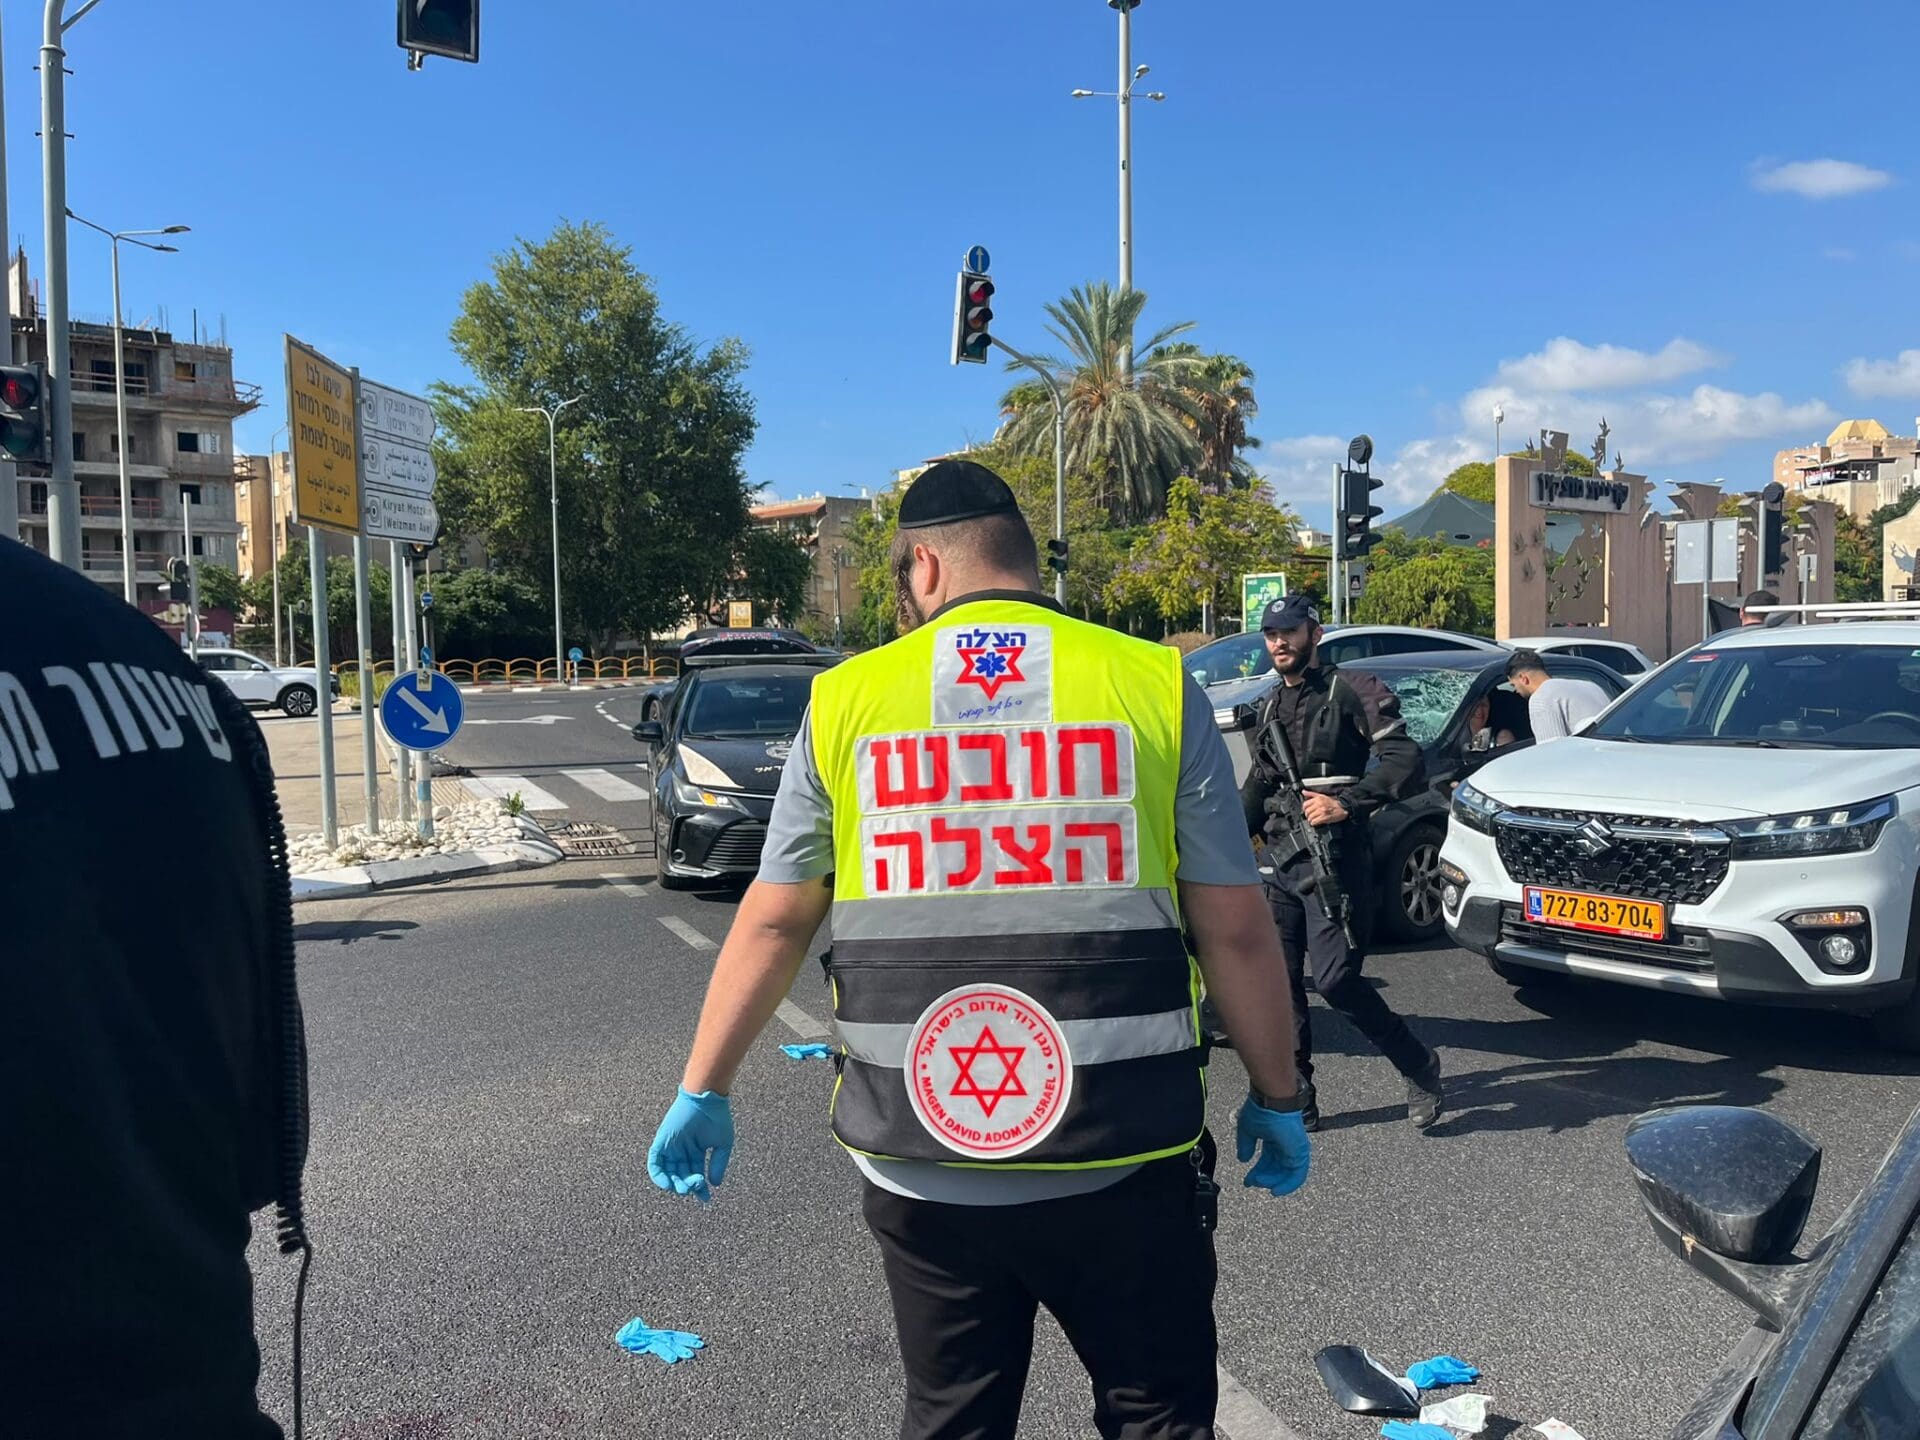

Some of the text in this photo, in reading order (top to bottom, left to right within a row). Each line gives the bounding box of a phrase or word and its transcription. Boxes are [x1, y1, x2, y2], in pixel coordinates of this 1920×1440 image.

[305, 362, 342, 399] שימו לב!
[295, 389, 353, 436] אין פנסי רמזור
[330, 435, 352, 460] מעבר
[383, 499, 405, 514] Kiryat
[956, 628, 1026, 648] הצלה
[869, 727, 1119, 808] חובש
[873, 817, 1125, 892] הצלה
[920, 1000, 1054, 1058] מגן דוד אדום בישראל
[921, 1076, 1057, 1143] MAGEN DAVID ADOM IN ISRAEL
